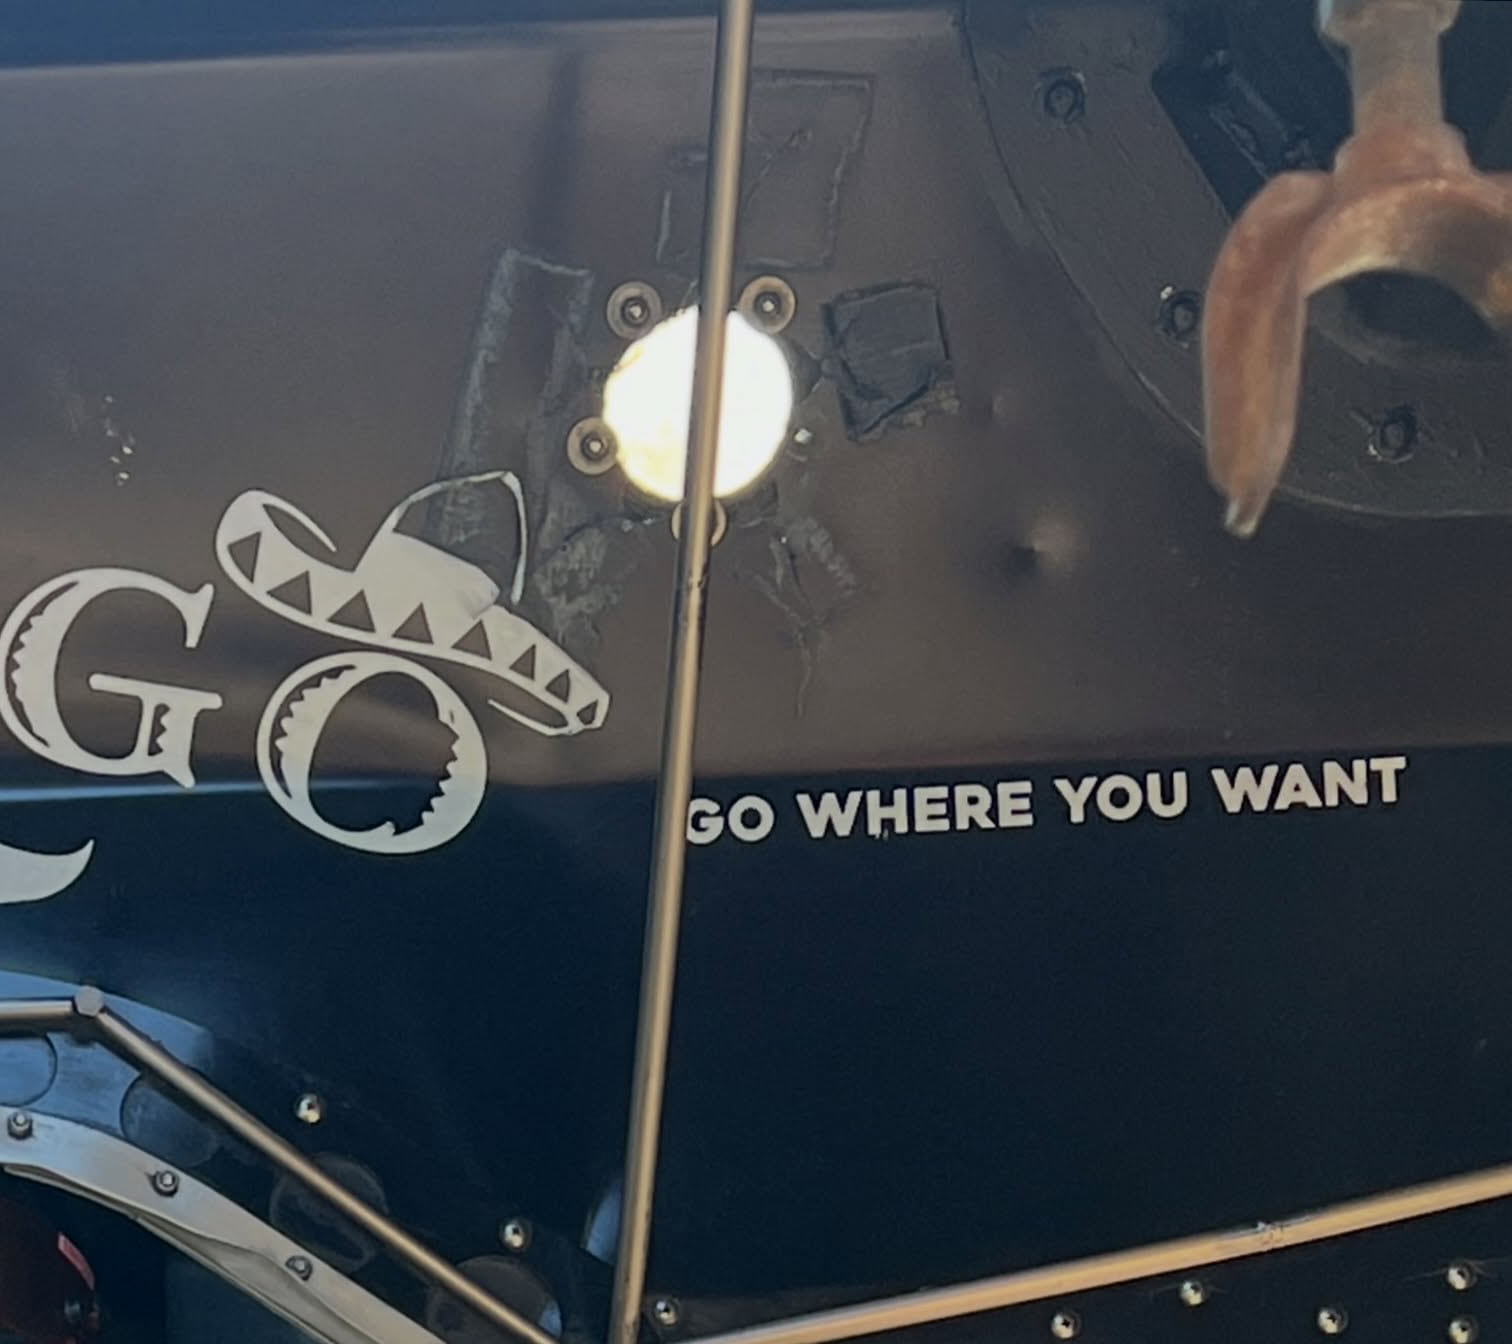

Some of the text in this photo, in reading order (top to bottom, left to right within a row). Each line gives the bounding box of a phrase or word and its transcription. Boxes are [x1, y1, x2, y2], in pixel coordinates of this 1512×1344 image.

[686, 756, 1407, 845] GO WHERE YOU WANT
